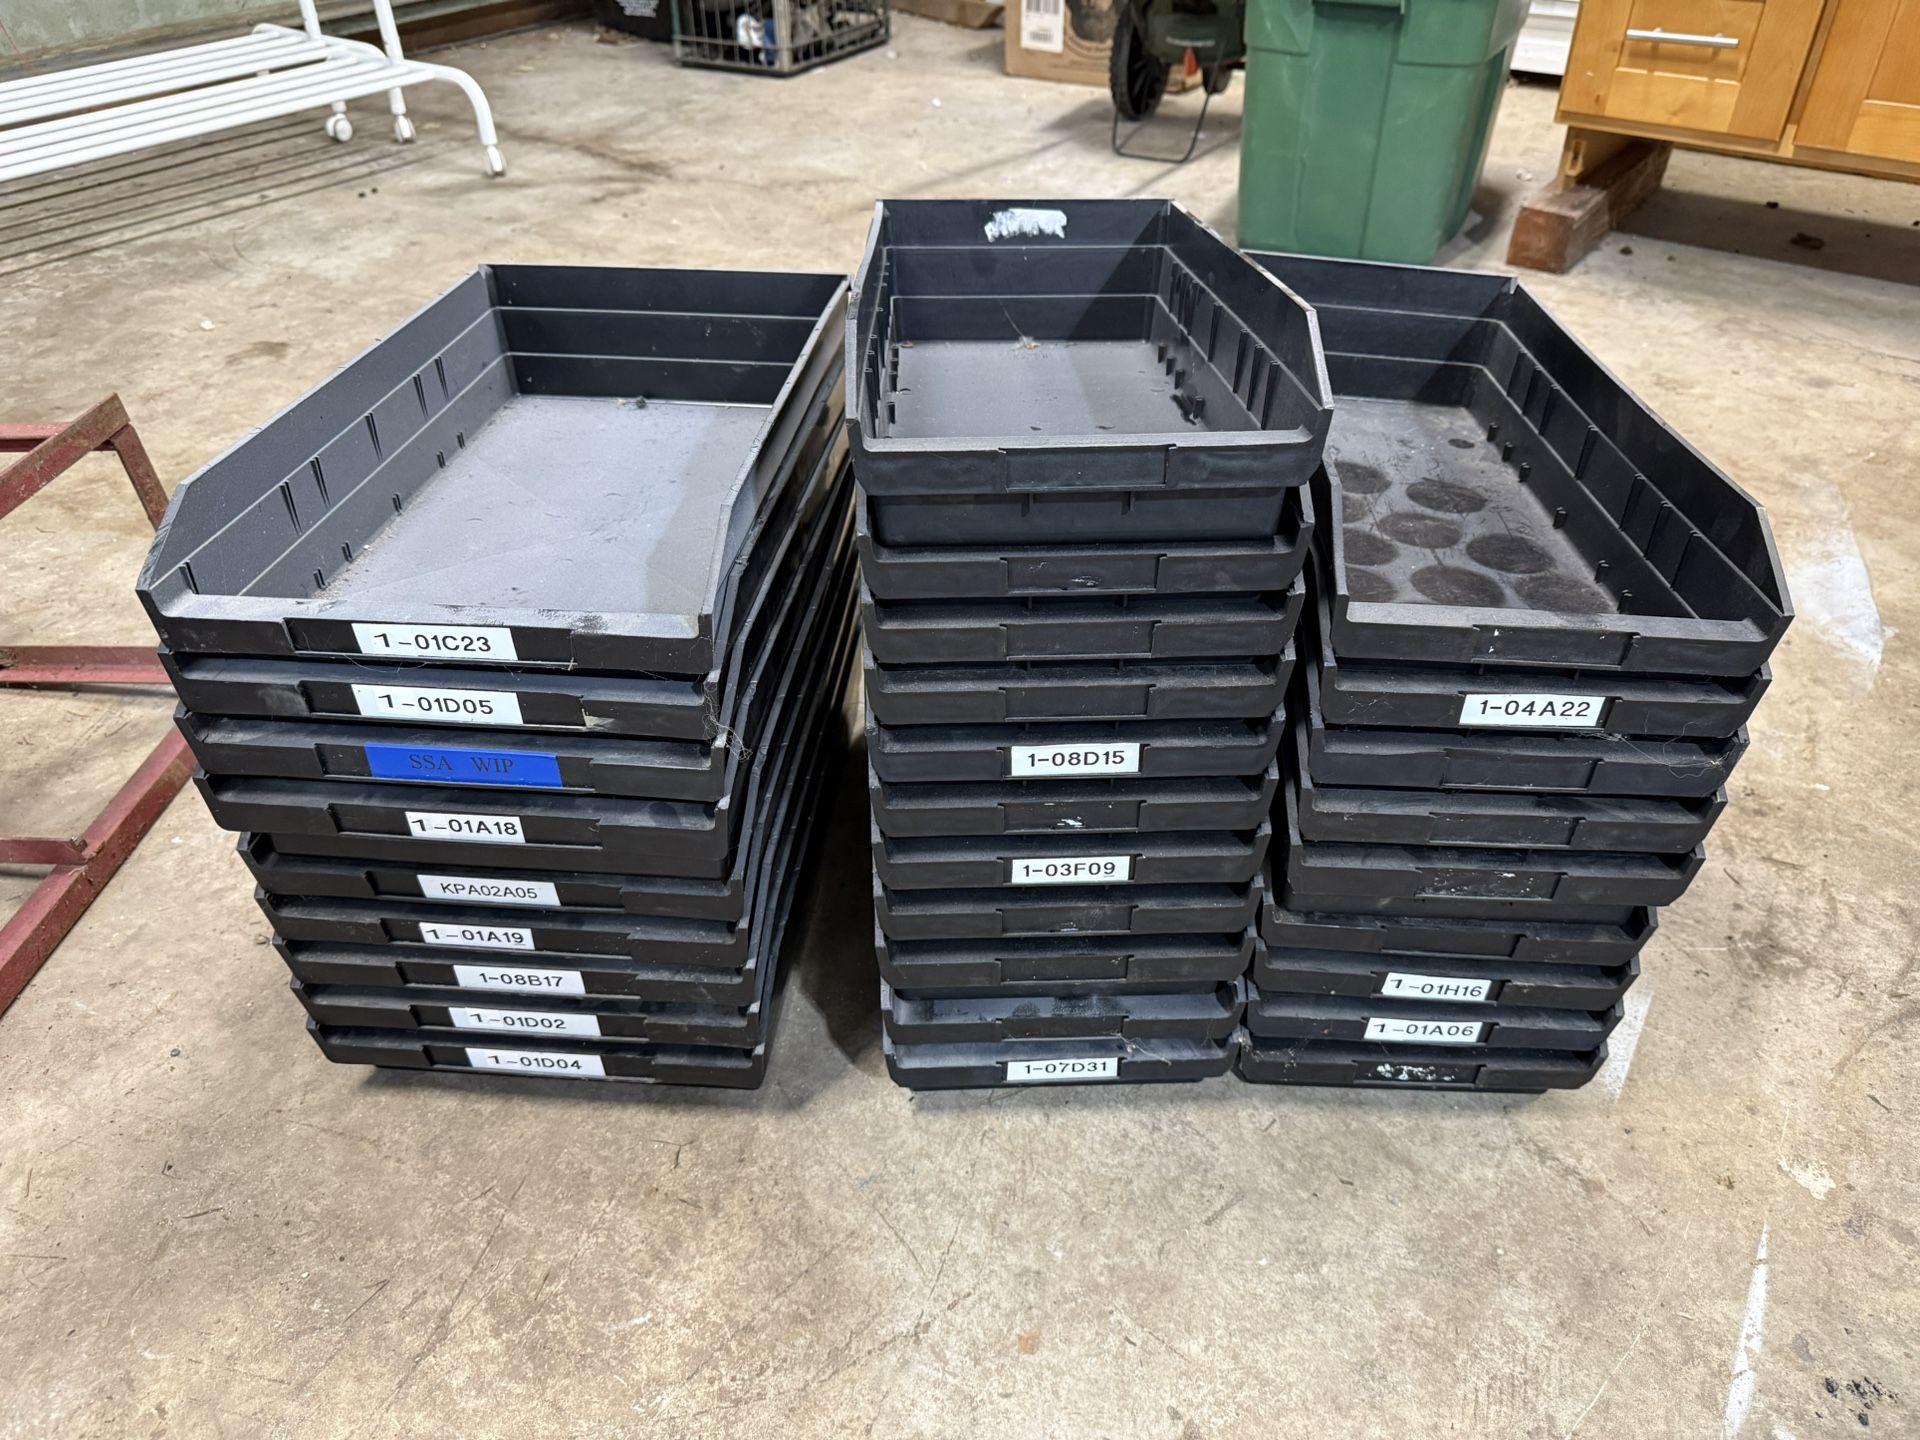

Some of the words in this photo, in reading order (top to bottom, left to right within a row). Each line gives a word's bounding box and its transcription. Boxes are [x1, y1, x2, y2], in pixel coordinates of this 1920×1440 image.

[1480, 699, 1591, 718] 1-04A22
[409, 754, 453, 772] SSA
[470, 757, 514, 774] WIP
[1027, 750, 1126, 768] 1-08D15
[1022, 860, 1116, 877] 1-03F09
[440, 882, 538, 900] KPA02A05
[479, 972, 564, 988] 1-08B17
[1024, 1060, 1109, 1075] 1-07D31
